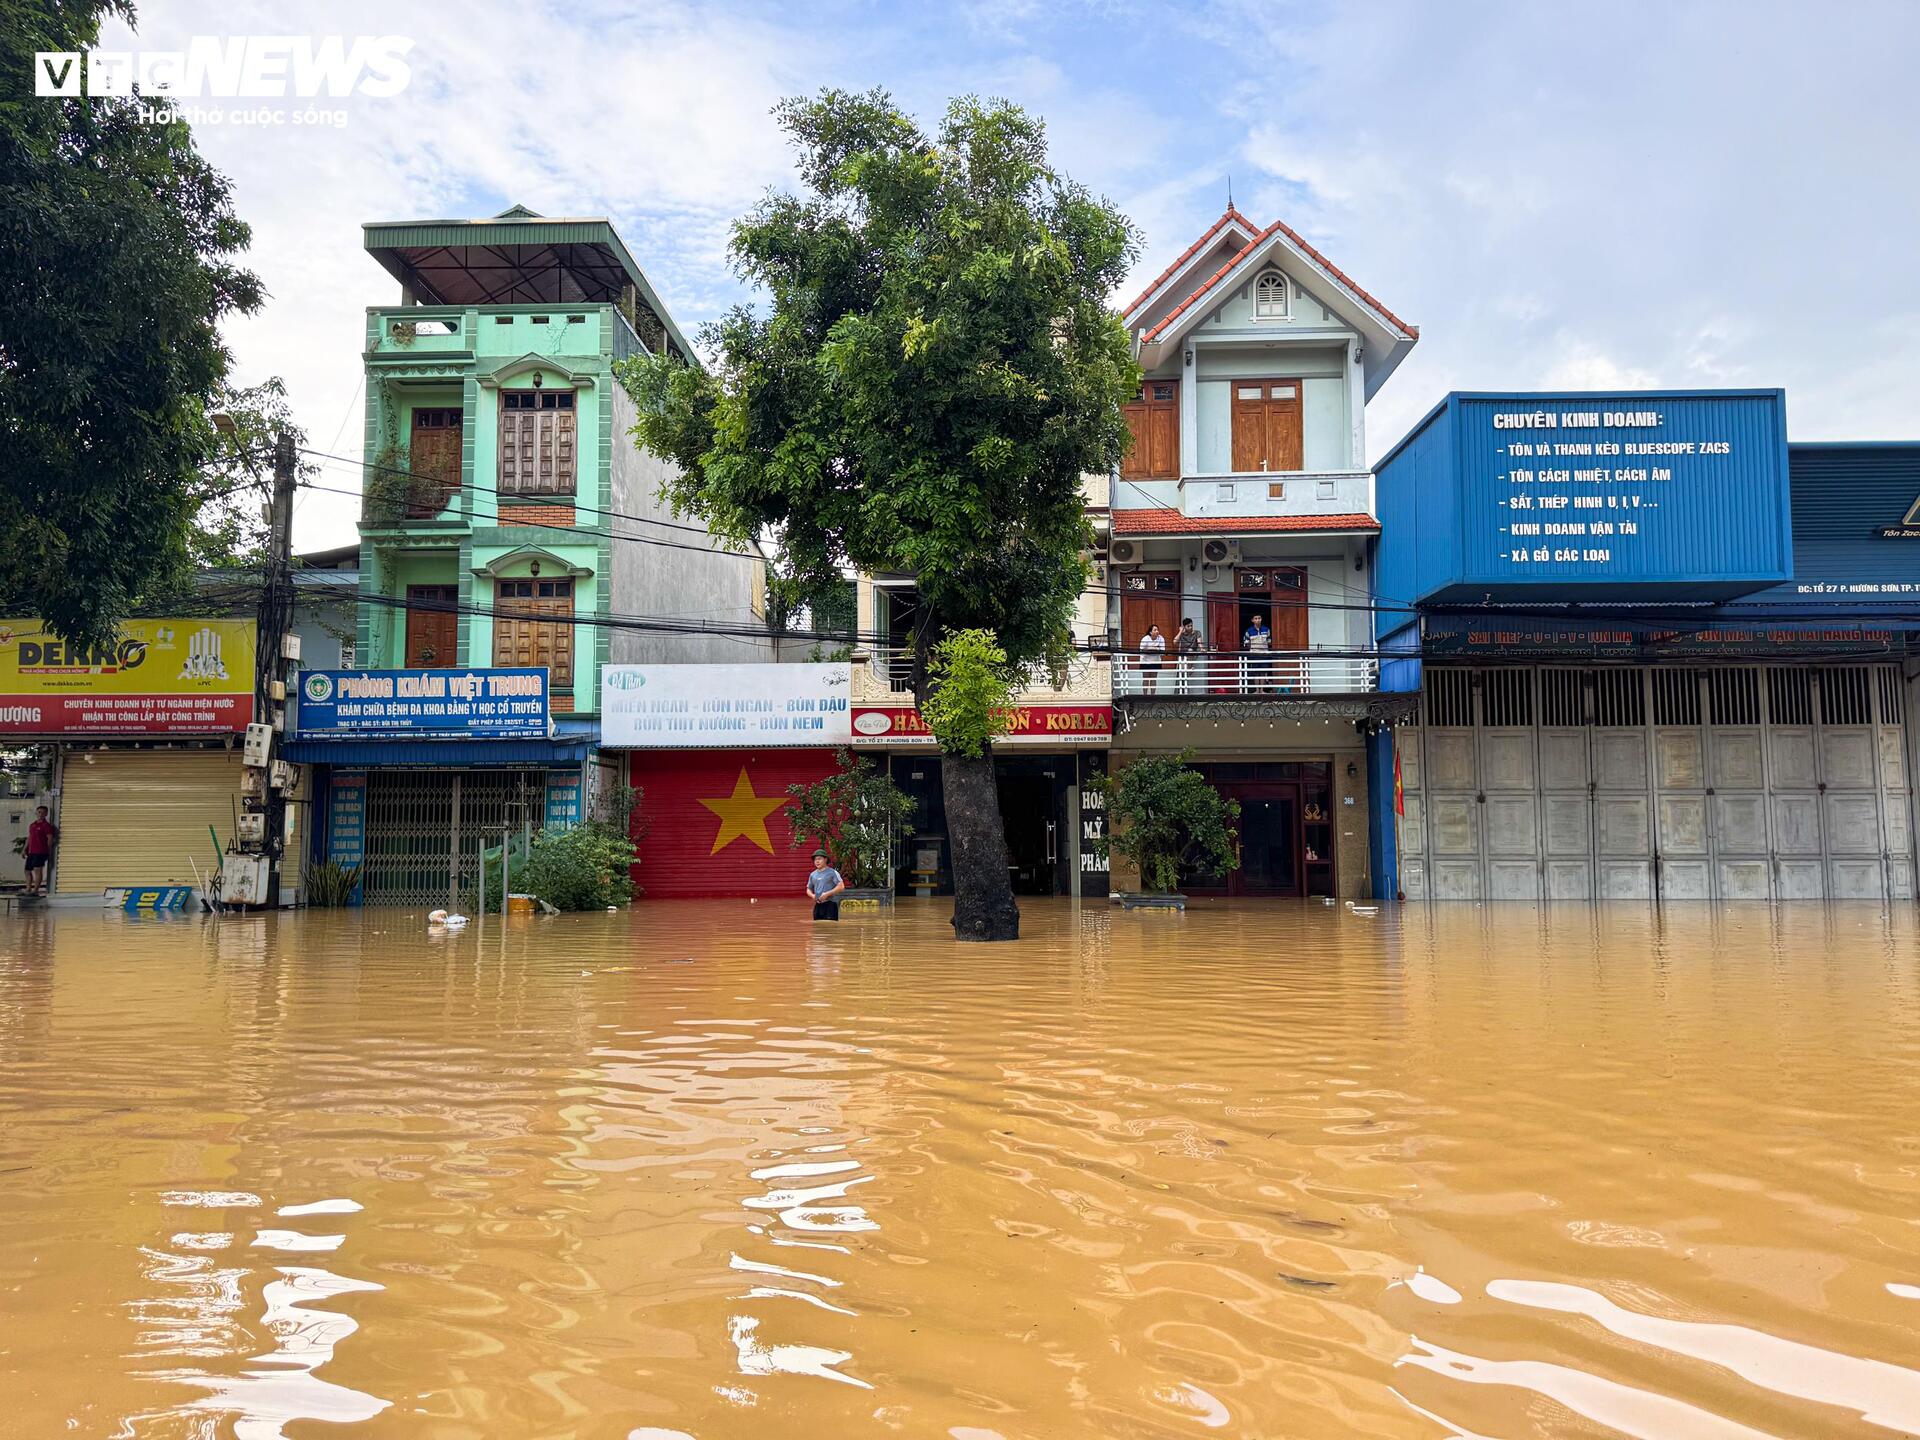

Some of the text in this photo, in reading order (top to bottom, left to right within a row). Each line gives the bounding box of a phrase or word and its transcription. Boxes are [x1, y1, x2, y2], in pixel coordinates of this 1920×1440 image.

[1494, 411, 1663, 428] CHUYÊN KINH DOANH:
[1508, 441, 1730, 456] TÔN VÀ THANH KÈO BLUESCOPE ZACS
[1510, 467, 1670, 484] TÔN CÁCH NHIỆT, CÁCH ÂM
[1510, 493, 1535, 510] SẮT,
[1538, 494, 1568, 509] THÉP
[1608, 496, 1619, 509] U,
[1511, 520, 1637, 537] KINH DOANH VẬN TẢI
[1883, 529, 1900, 537] Tôn
[1512, 548, 1529, 562] XÀ
[1554, 547, 1579, 561] CÁC
[1583, 550, 1610, 564] LOẠI
[1826, 585, 1838, 593] 27
[1850, 583, 1879, 592] HƯƠNG
[338, 673, 393, 698] PHÒNG
[397, 673, 445, 697] KHÁM
[449, 673, 484, 701] VIỆT
[488, 675, 542, 696] TRUNG
[64, 698, 234, 710] CHUYÊN KINH DOANH VẬT TƯ NGÀNH ĐIỆN NƯỚC
[337, 702, 360, 716] KHÁM
[363, 702, 385, 716] CHỮA
[387, 702, 408, 717] BỆNH
[410, 704, 421, 715] ĐA
[424, 703, 445, 715] KHOA
[471, 703, 477, 714] Y
[479, 703, 495, 717] HỌC
[702, 697, 730, 712] BÚN
[735, 700, 773, 712] NGAN
[786, 696, 815, 711] BÚN
[820, 696, 847, 714] ĐẬU
[82, 710, 215, 723] NHẬN THI CÔNG LẮP ĐẶT CÔNG TRÌNH
[760, 714, 788, 730] BÚN
[792, 717, 823, 729] NEM
[1046, 713, 1108, 730] KOREA
[1084, 816, 1103, 839] MỸ
